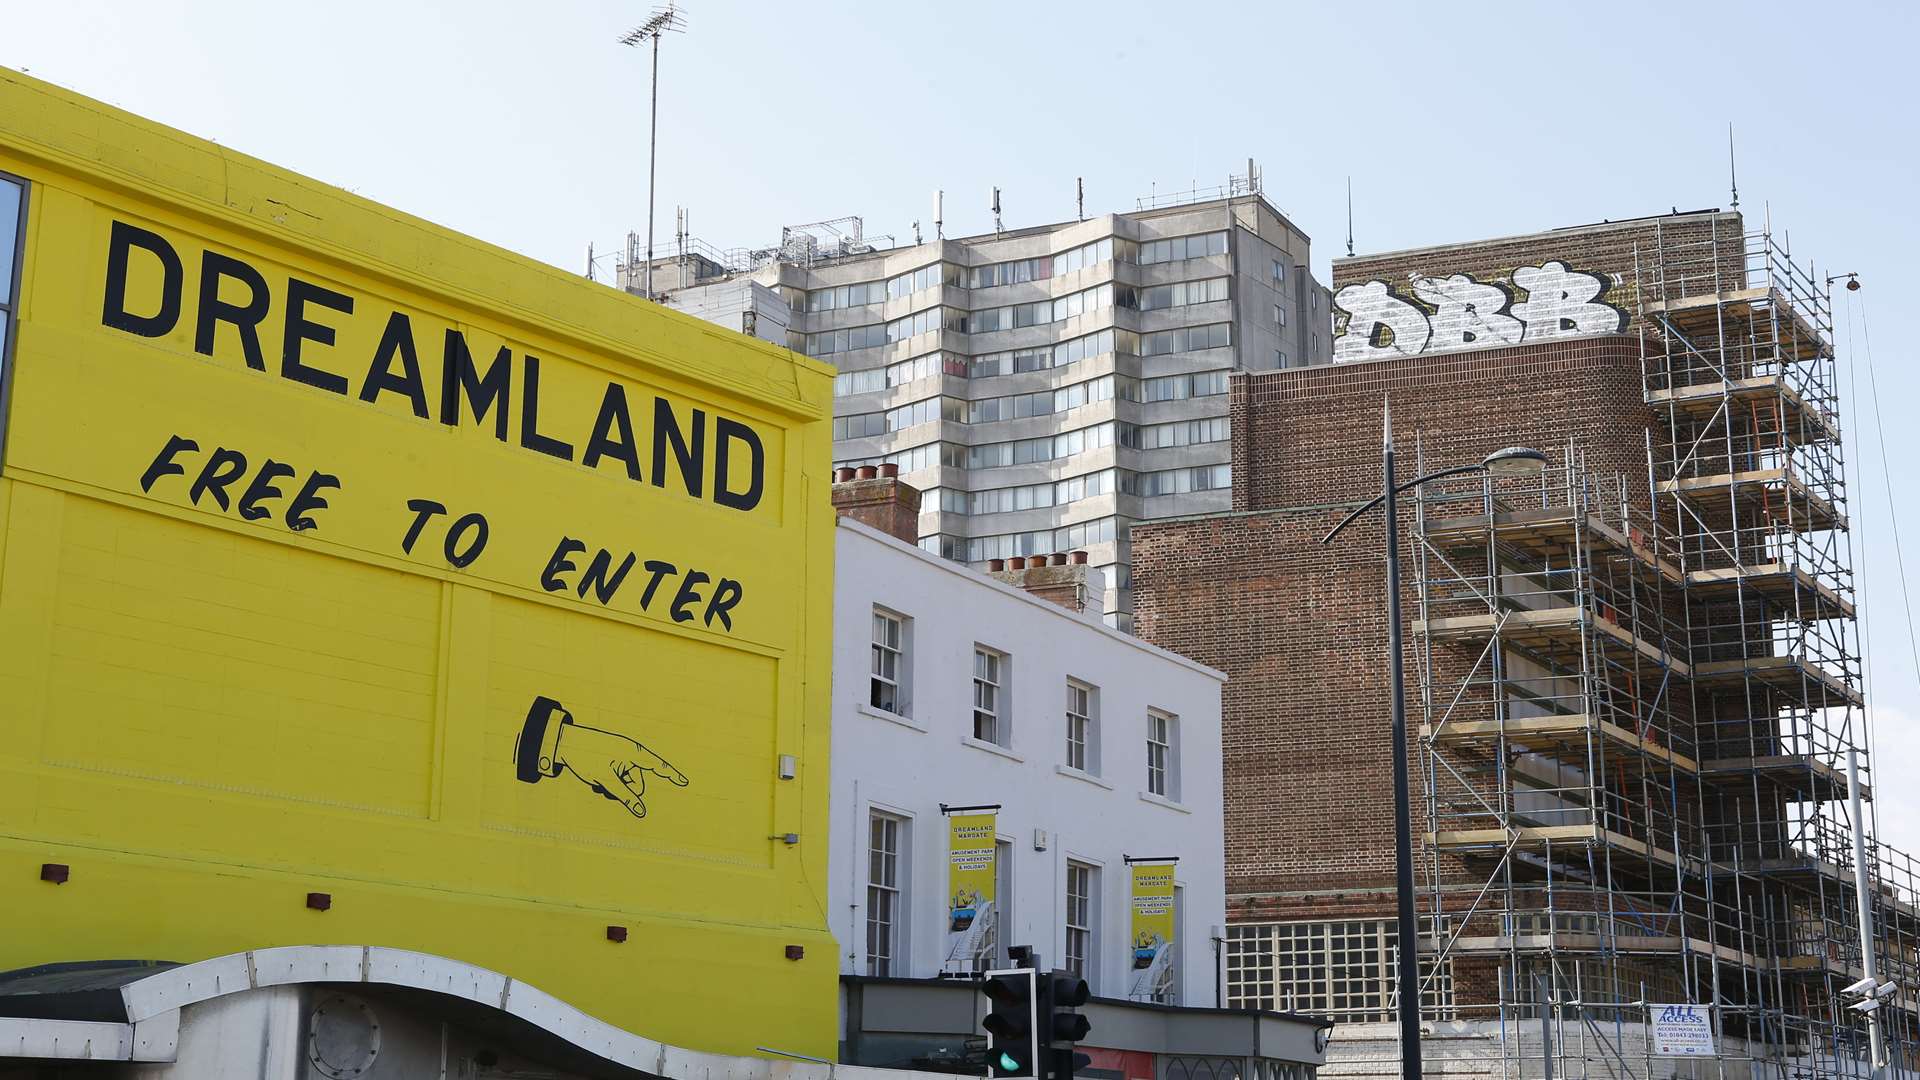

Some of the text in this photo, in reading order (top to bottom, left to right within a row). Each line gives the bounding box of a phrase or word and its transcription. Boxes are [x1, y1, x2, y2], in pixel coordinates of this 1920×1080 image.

[102, 220, 765, 511] DREAMLAND
[140, 435, 743, 632] FREE TO ENTER
[953, 825, 993, 833] DREAMLAND
[1662, 1006, 1697, 1017] ALL
[1658, 1015, 1703, 1023] ACCESS
